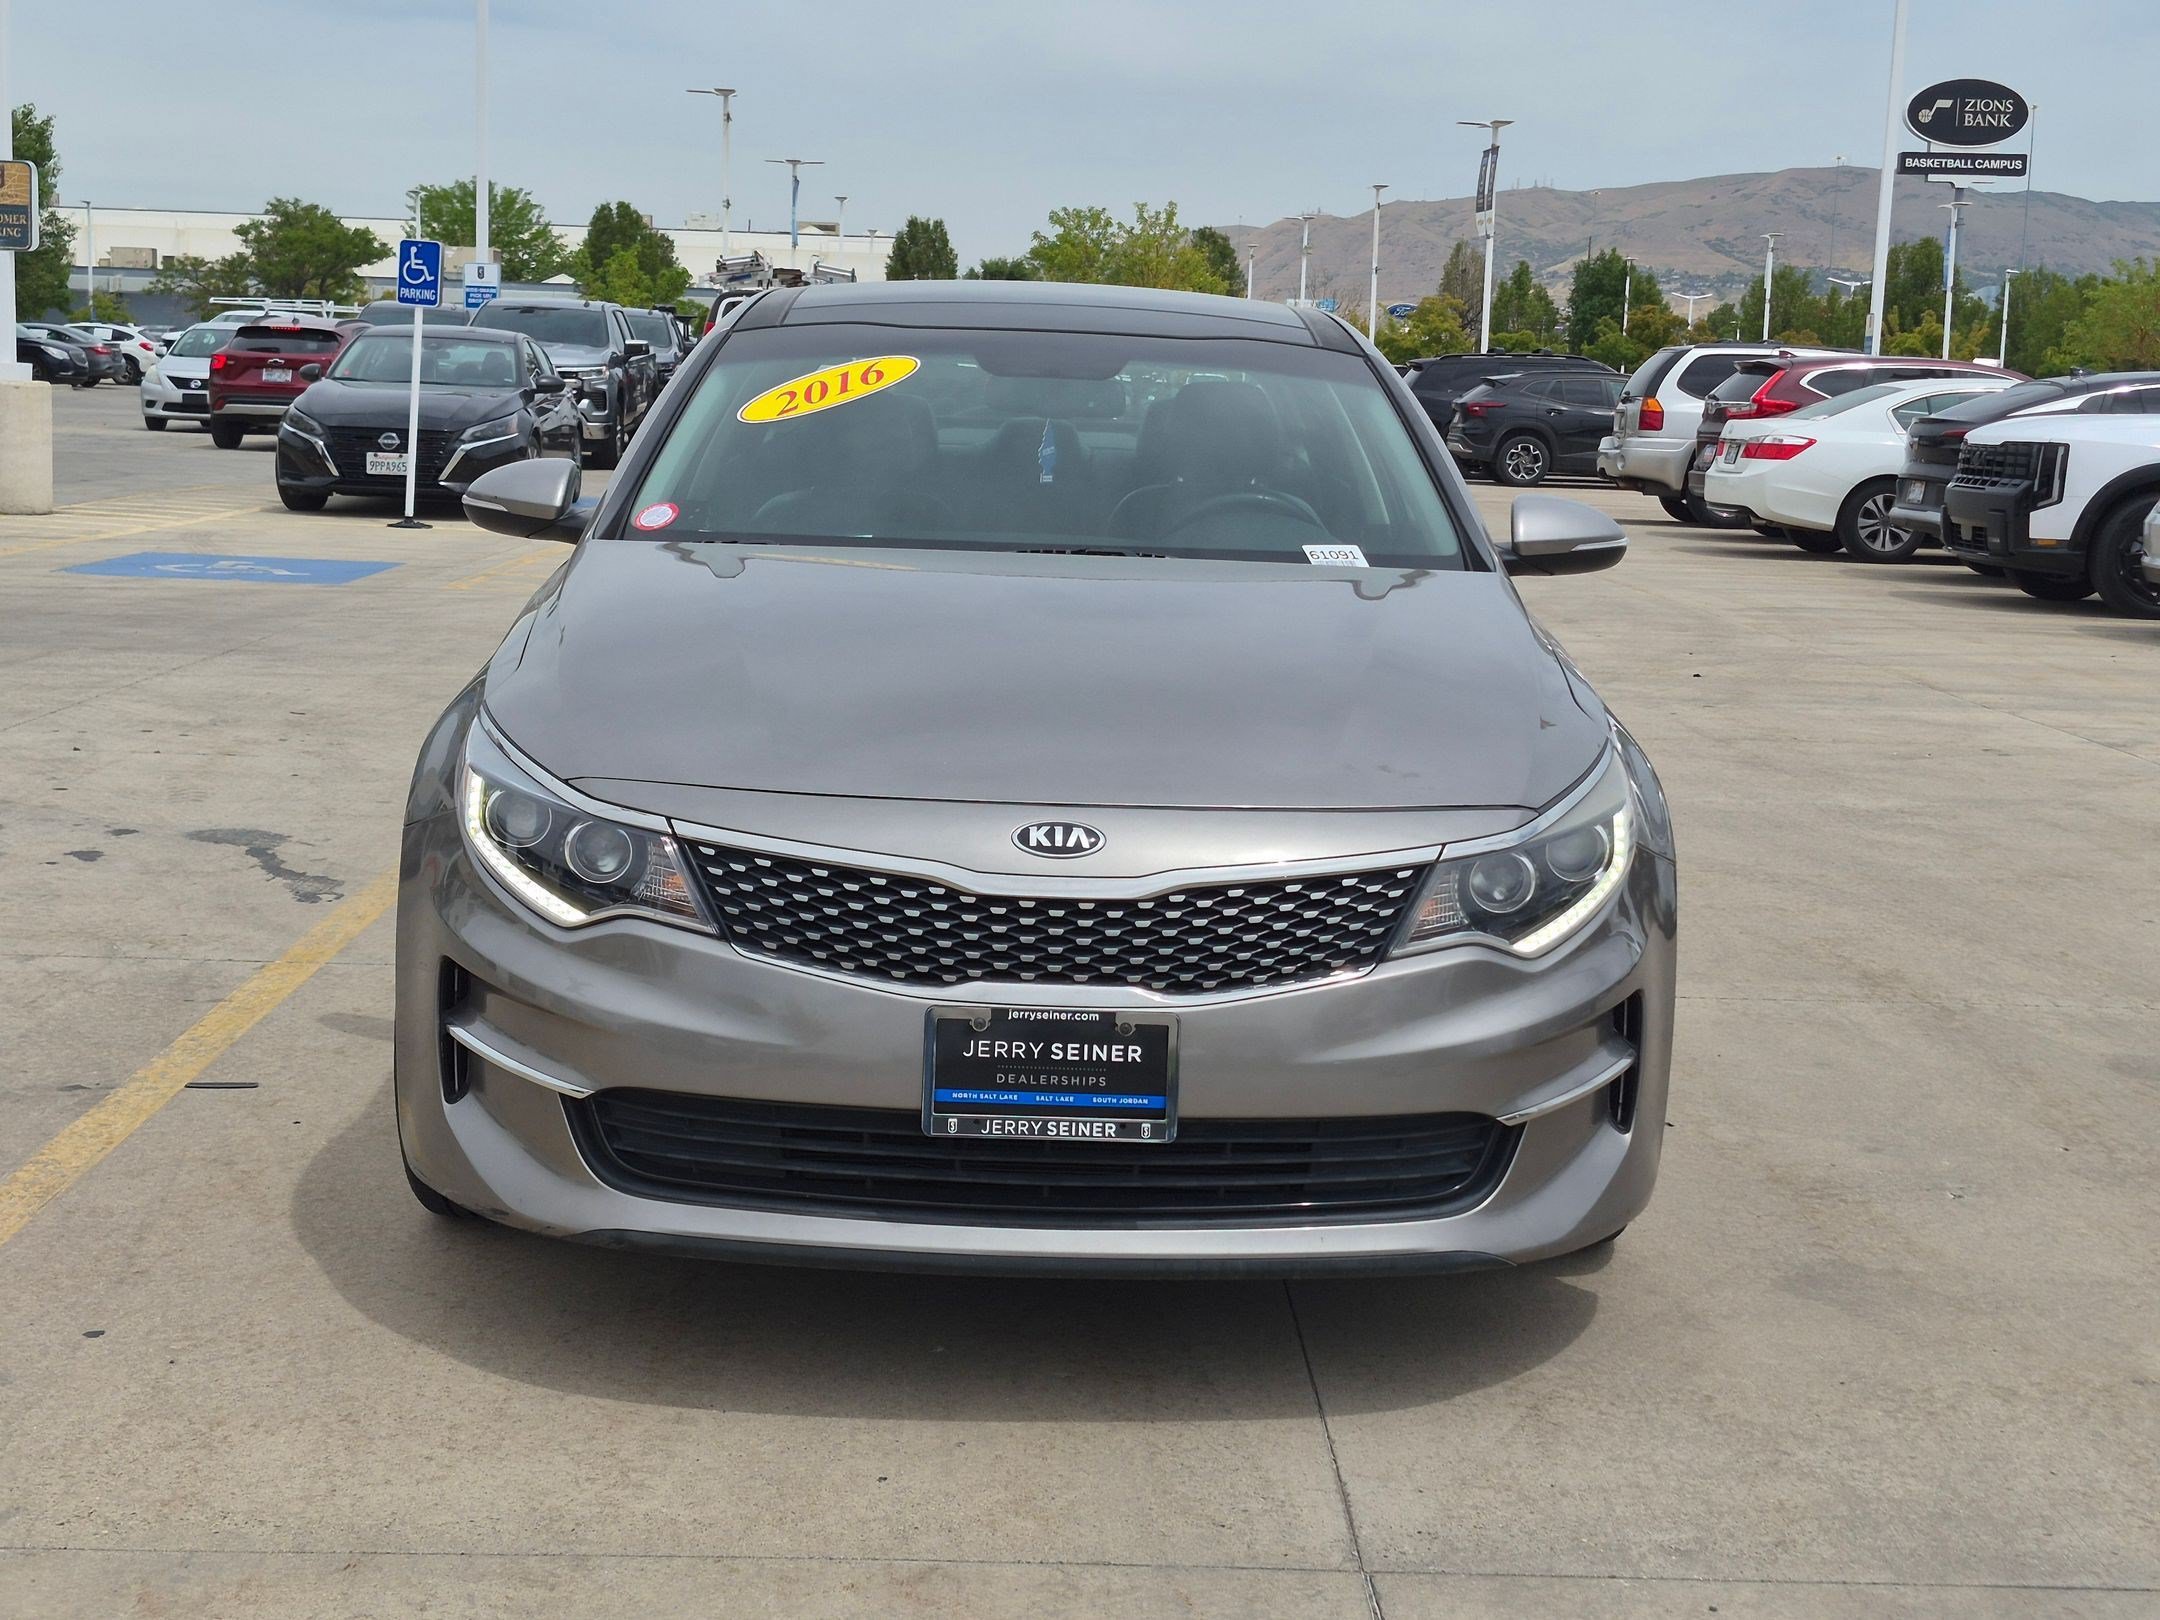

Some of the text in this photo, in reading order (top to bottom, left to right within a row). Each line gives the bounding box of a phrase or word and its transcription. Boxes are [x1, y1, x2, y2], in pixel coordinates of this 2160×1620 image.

[1964, 99, 2014, 112] ZIONS
[1964, 113, 2013, 127] BANK
[1905, 157, 2023, 170] BASKETBALL CAMPUS
[400, 287, 436, 301] PARKING
[776, 360, 885, 417] 2016
[369, 460, 408, 472] 9PPA965
[1309, 550, 1359, 560] 61091
[1028, 825, 1091, 849] KIA
[1008, 1008, 1100, 1021] jerryseiner.com
[963, 1039, 1142, 1063] JERRY SEINER
[996, 1073, 1107, 1087] DEALERSHIPS
[1118, 1097, 1149, 1105] JORDAN
[981, 1120, 1116, 1137] JERRY SEINER
